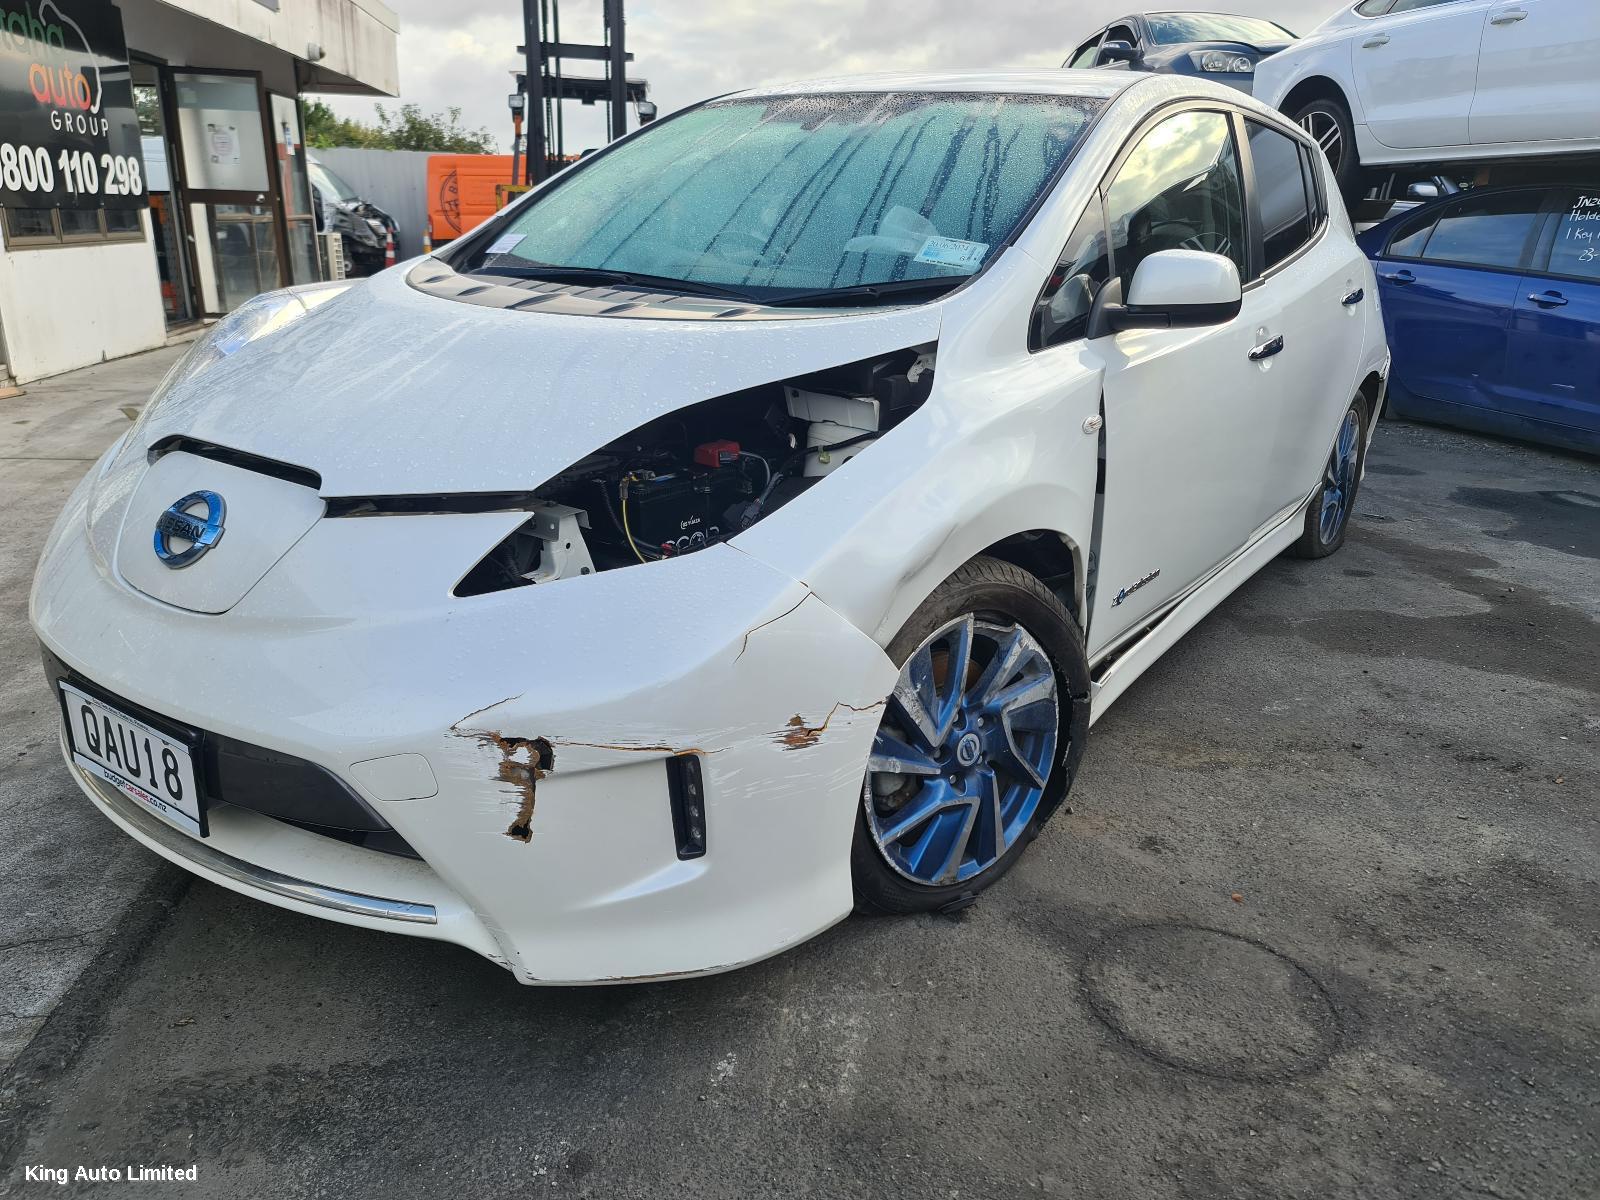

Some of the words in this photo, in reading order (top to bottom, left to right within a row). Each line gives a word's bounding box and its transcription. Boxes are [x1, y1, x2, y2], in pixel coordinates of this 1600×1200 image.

[29, 63, 91, 111] auto
[51, 110, 109, 137] GROUP
[0, 143, 54, 193] 800
[58, 149, 99, 194] 110
[100, 154, 142, 196] 298
[1574, 228, 1593, 244] Key
[80, 704, 183, 801] QAU18
[104, 769, 167, 813] budgetcarsales.co.nz
